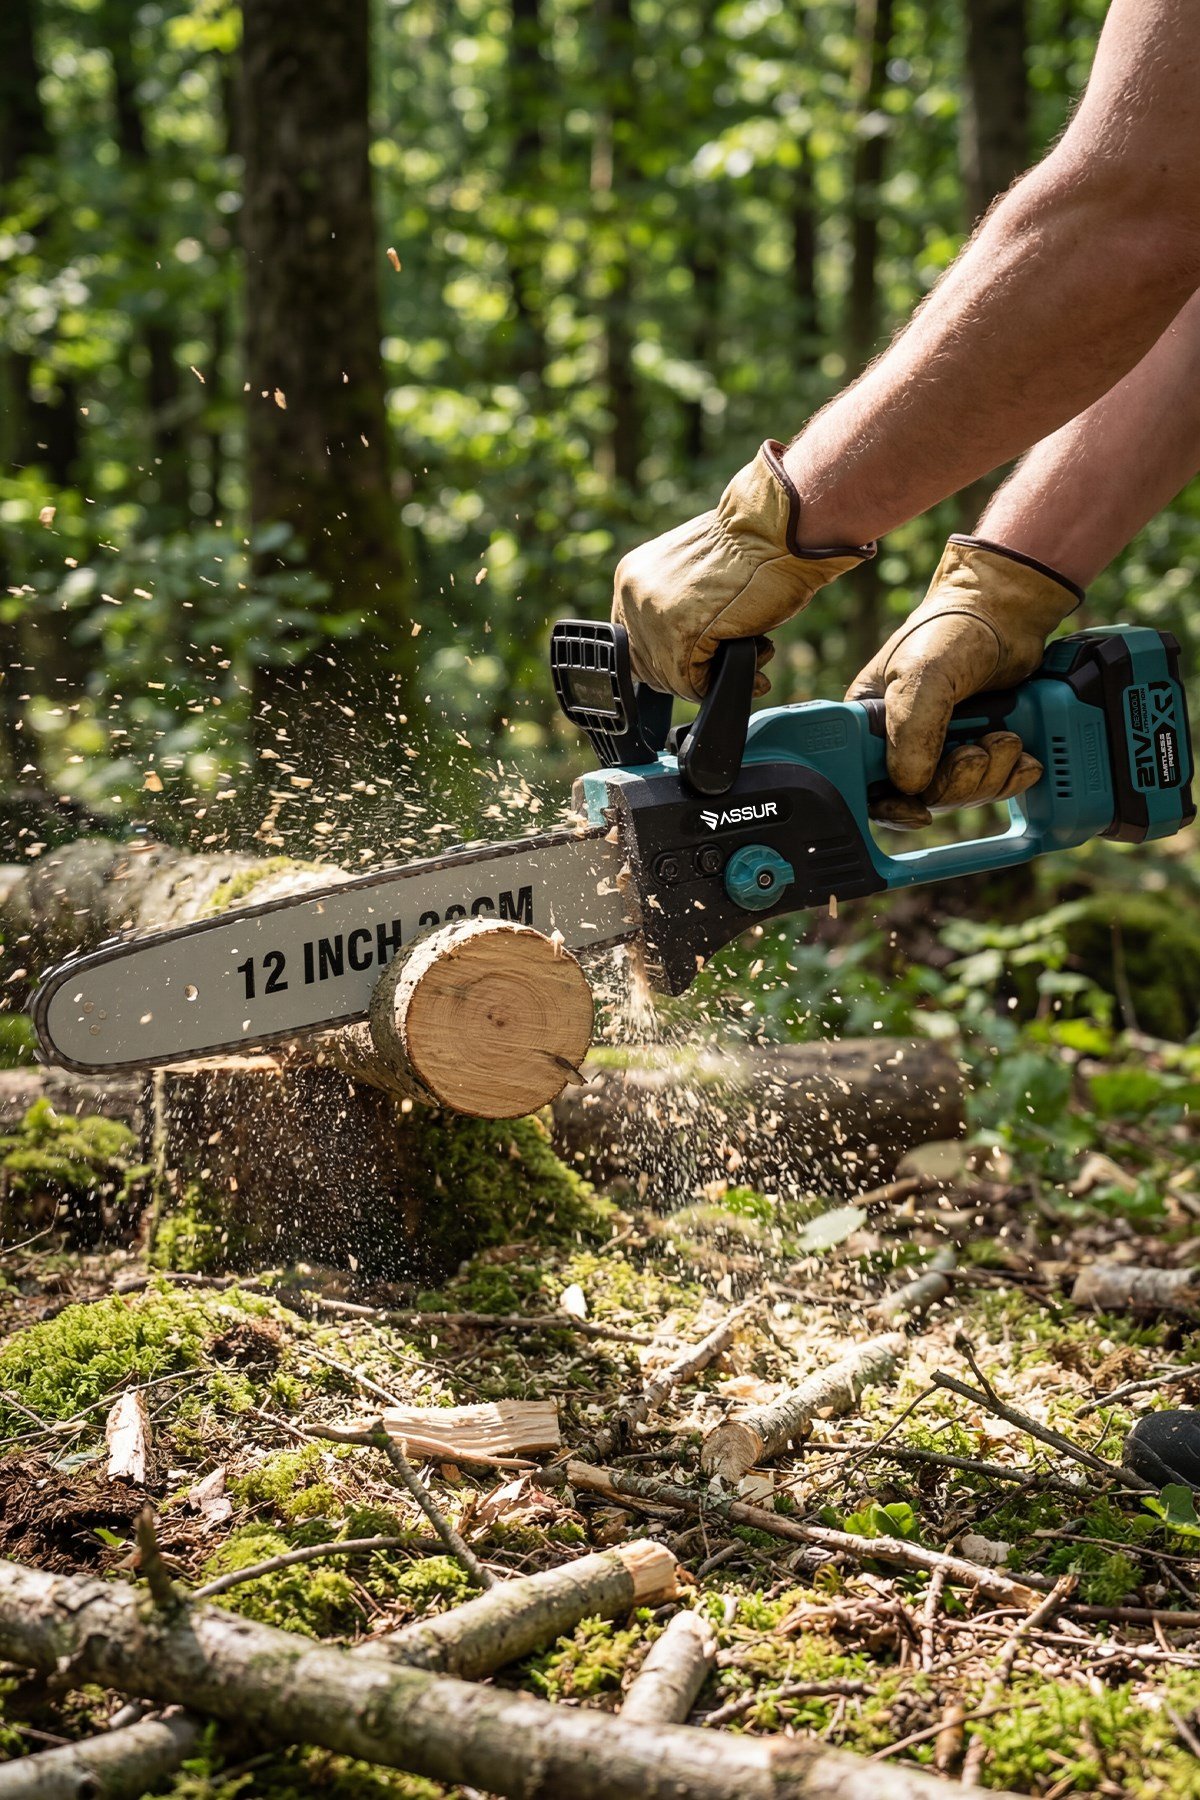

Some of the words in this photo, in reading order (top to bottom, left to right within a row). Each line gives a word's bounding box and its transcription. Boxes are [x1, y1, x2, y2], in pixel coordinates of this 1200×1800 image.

[1130, 692, 1141, 728] DEXVOLT
[1141, 703, 1150, 734] LITHIUM
[1132, 732, 1156, 788] 21V
[1159, 733, 1170, 782] LIMITLESS
[1165, 732, 1175, 767] POWER
[719, 801, 778, 826] ASSUR
[237, 950, 289, 1000] 12
[303, 919, 402, 985] INCH
